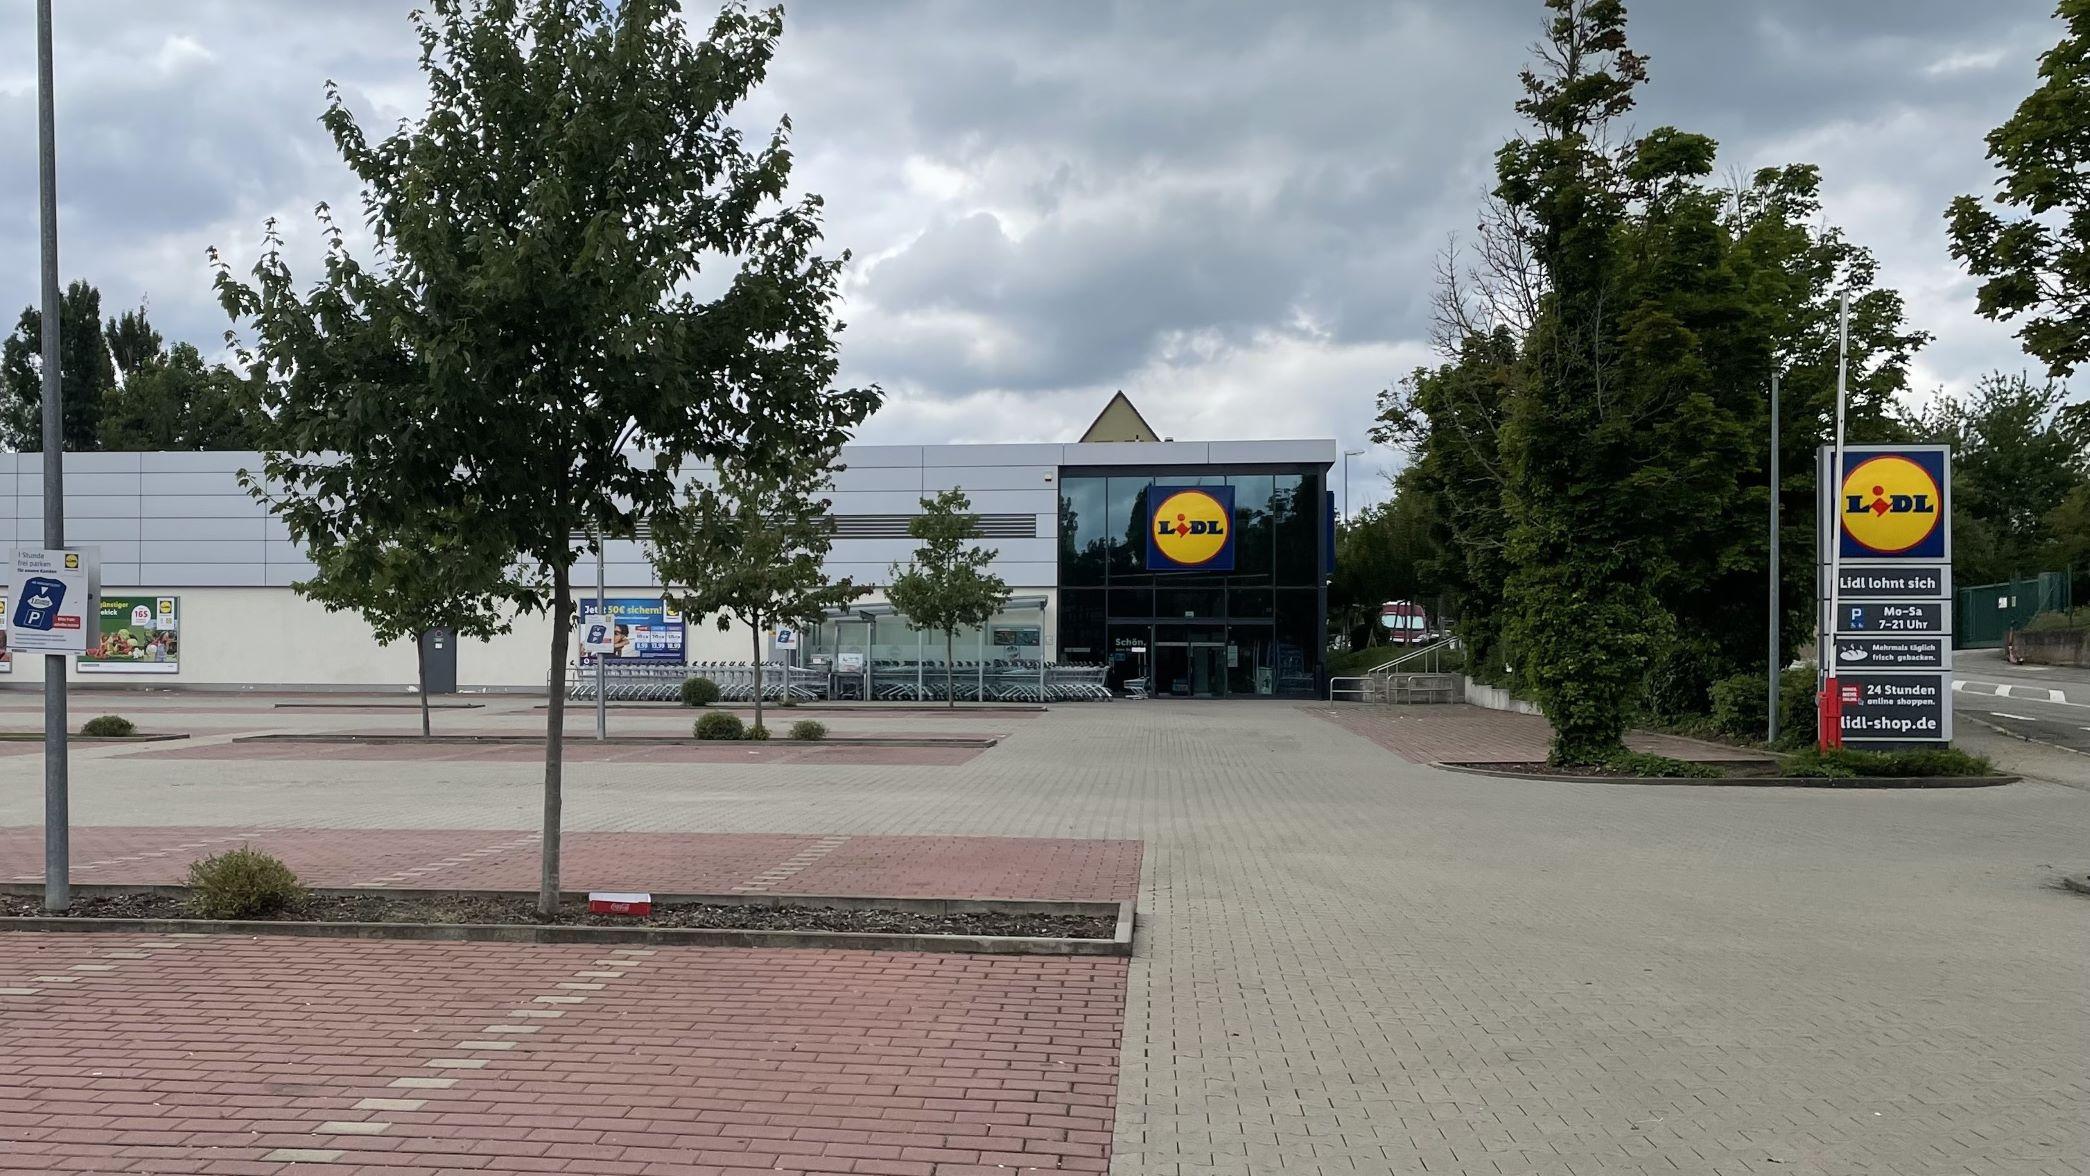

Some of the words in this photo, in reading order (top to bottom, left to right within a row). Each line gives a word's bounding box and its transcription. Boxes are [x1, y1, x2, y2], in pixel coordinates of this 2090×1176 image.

[22, 551, 44, 559] Stunde
[17, 559, 28, 567] frei
[29, 560, 52, 568] parken
[1840, 576, 1866, 589] Lidl
[1868, 576, 1905, 589] lohnt
[1907, 576, 1936, 589] sich
[584, 605, 607, 614] Jett
[627, 605, 662, 614] sichern!
[1851, 608, 1862, 620] P
[28, 611, 40, 624] P
[1906, 619, 1928, 629] Uhr
[1909, 644, 1936, 652] täglich
[1872, 653, 1894, 661] frisch
[1897, 653, 1936, 662] gebacken.
[1867, 684, 1881, 695] 24
[1884, 684, 1936, 695] Stunden
[1867, 697, 1894, 705] online
[1896, 697, 1936, 707] shoppen.
[1840, 716, 1937, 732] lidl-shop.de
